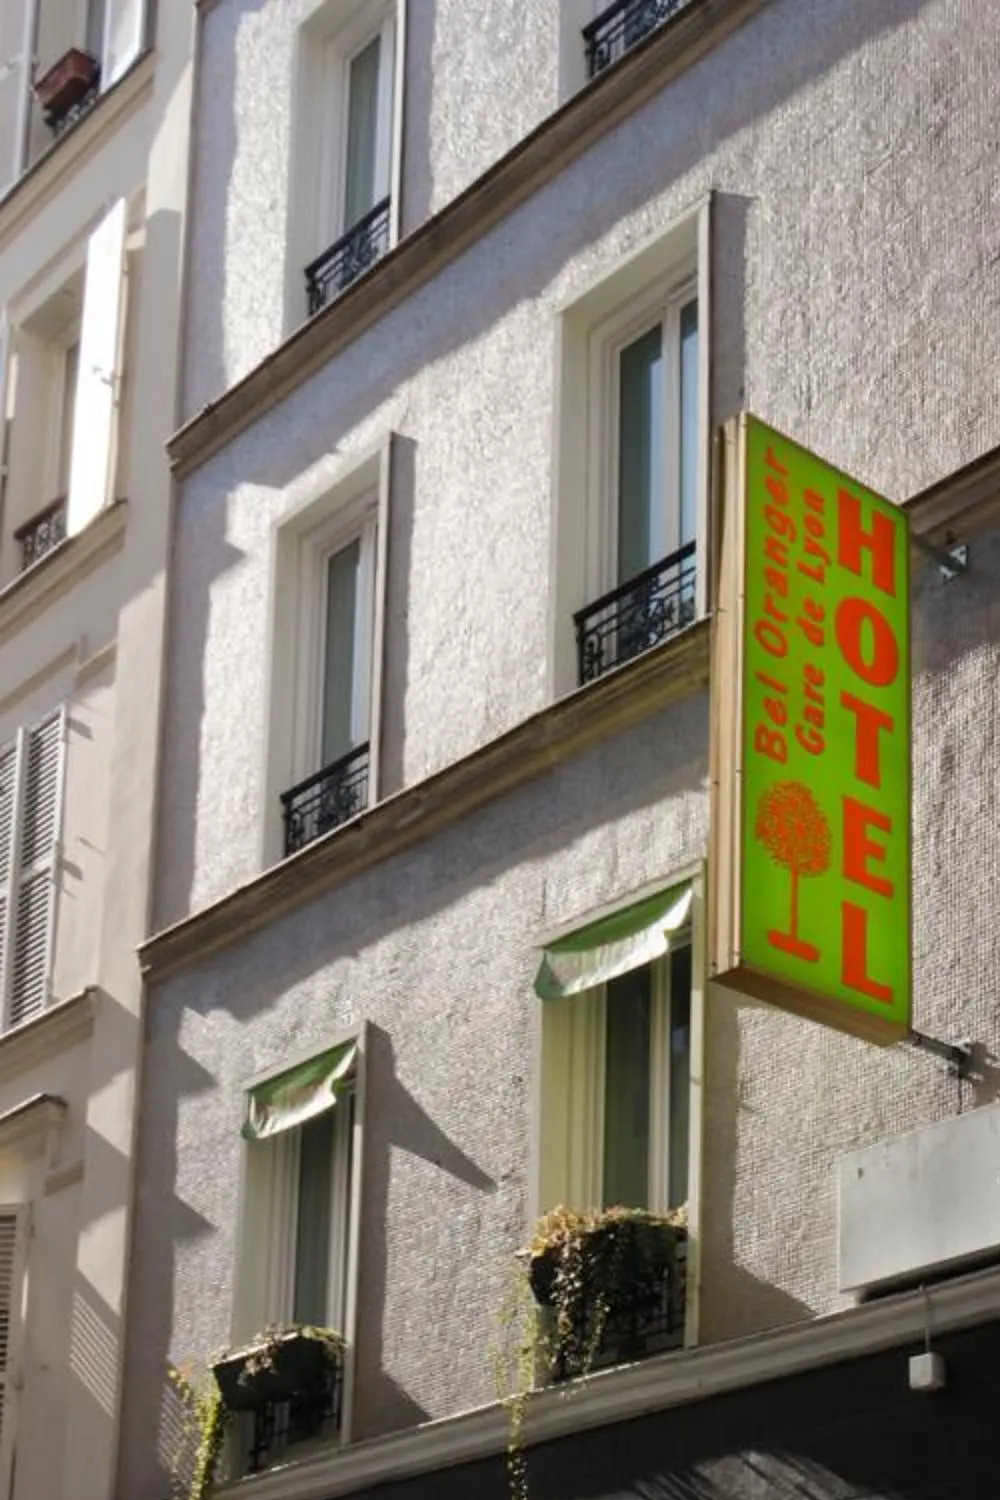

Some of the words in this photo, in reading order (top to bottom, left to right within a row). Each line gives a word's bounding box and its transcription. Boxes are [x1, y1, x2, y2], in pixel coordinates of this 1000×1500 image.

[753, 446, 797, 658] Oranger
[796, 487, 832, 585] Lyon
[796, 596, 826, 648] de
[754, 670, 789, 765] Bel
[795, 663, 826, 757] Gare
[834, 486, 900, 1006] HOTEL
